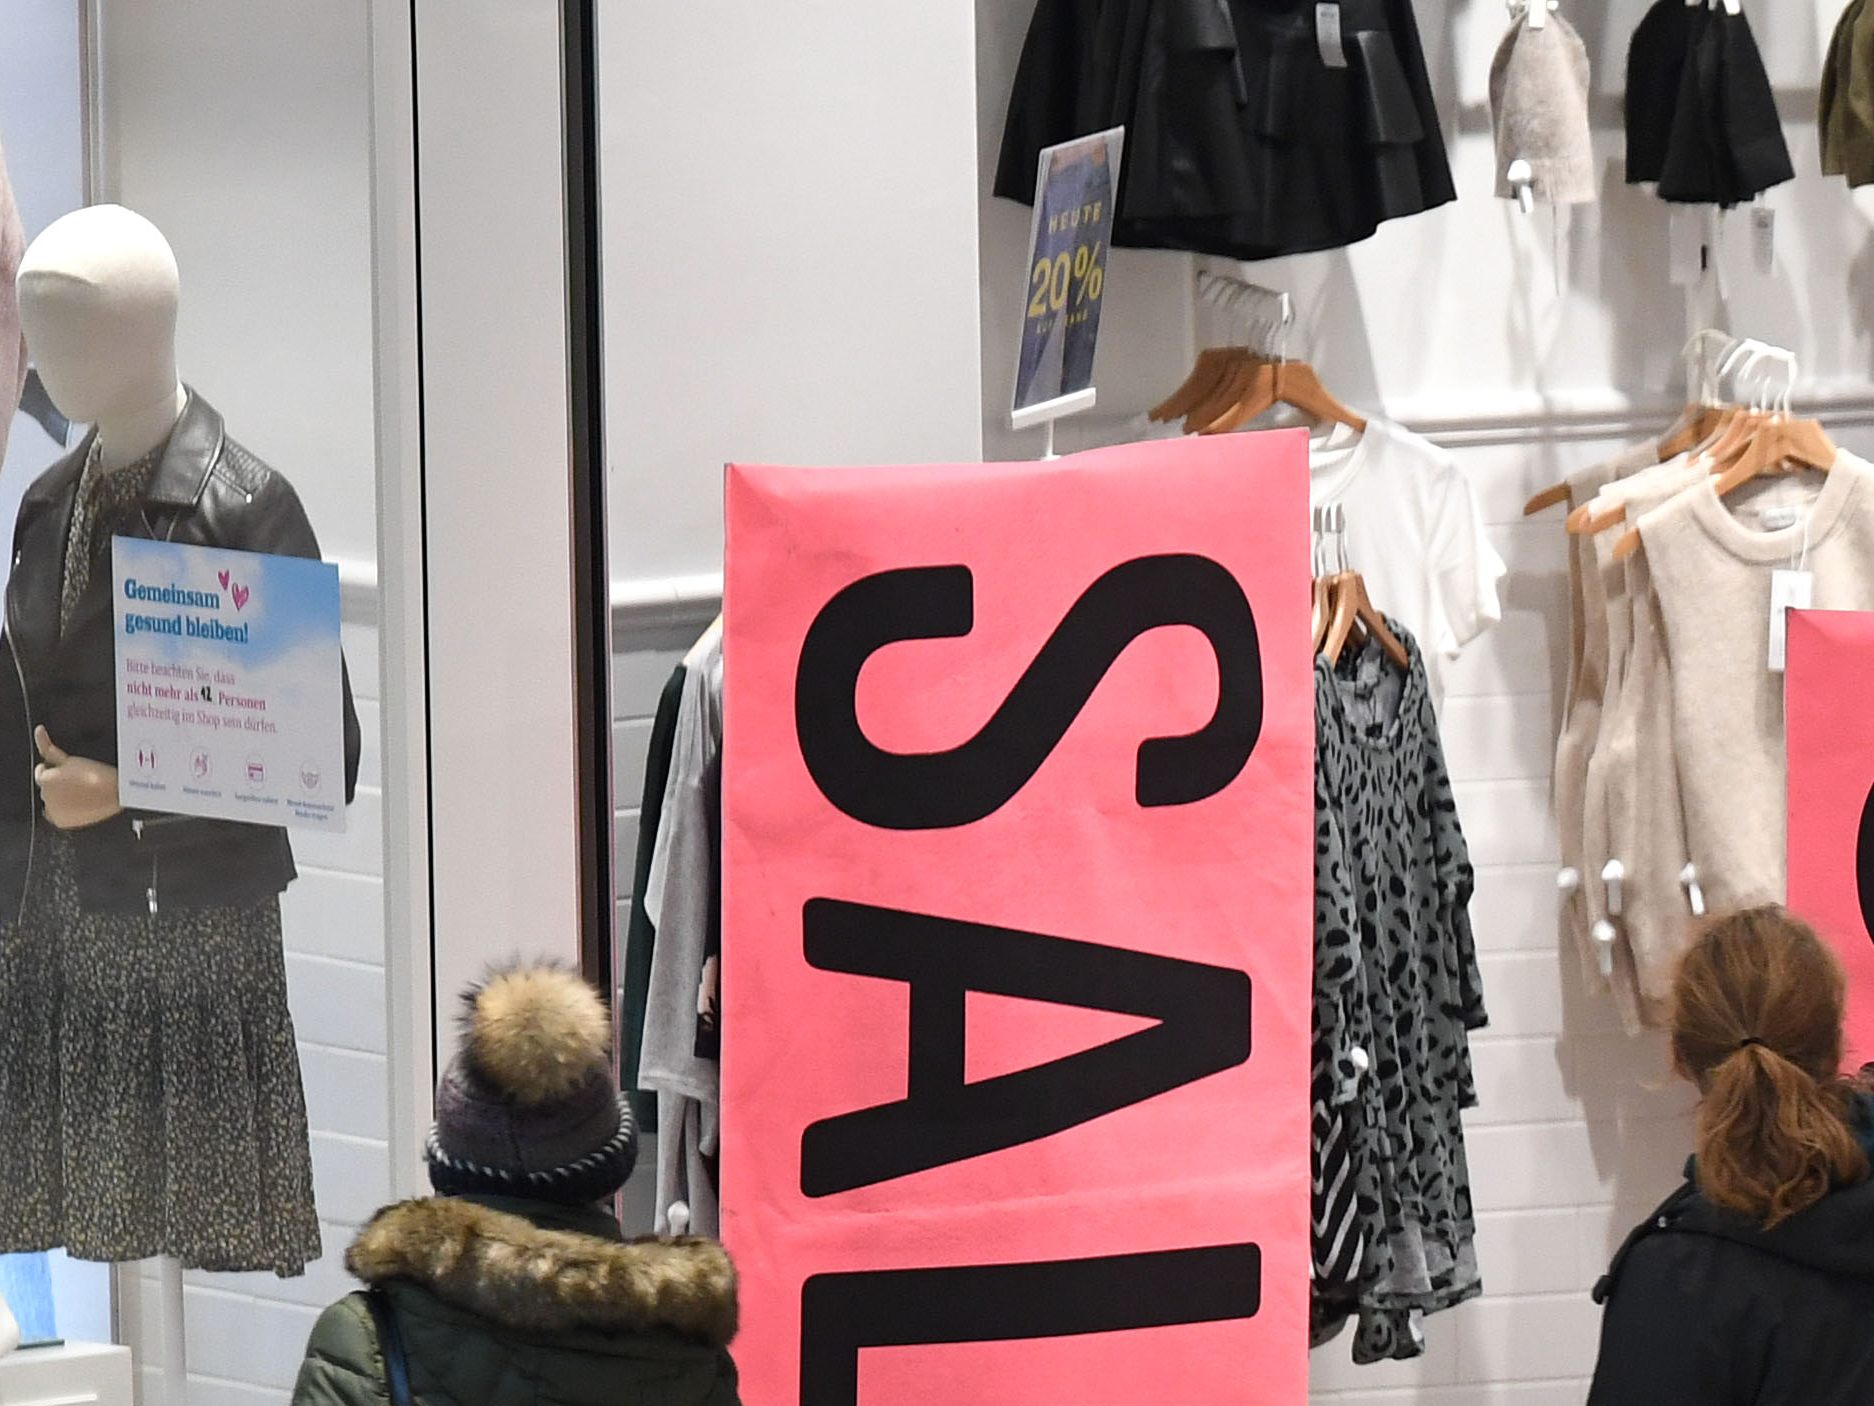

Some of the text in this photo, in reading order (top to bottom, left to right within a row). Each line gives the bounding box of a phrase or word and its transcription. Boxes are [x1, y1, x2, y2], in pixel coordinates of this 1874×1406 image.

[1049, 202, 1102, 234] HEUTE
[1028, 241, 1103, 317] 20%
[124, 578, 220, 609] Gemeinsam
[125, 613, 249, 644] gesund bleiben!
[126, 658, 149, 674] Bitte
[151, 661, 194, 681] beachten
[213, 669, 236, 686] dass
[127, 681, 152, 697] nicht
[155, 685, 181, 701] mehr
[184, 687, 199, 703] als
[218, 692, 267, 712] Personen
[127, 702, 180, 725] gleichzeitig
[196, 709, 221, 731] Shop
